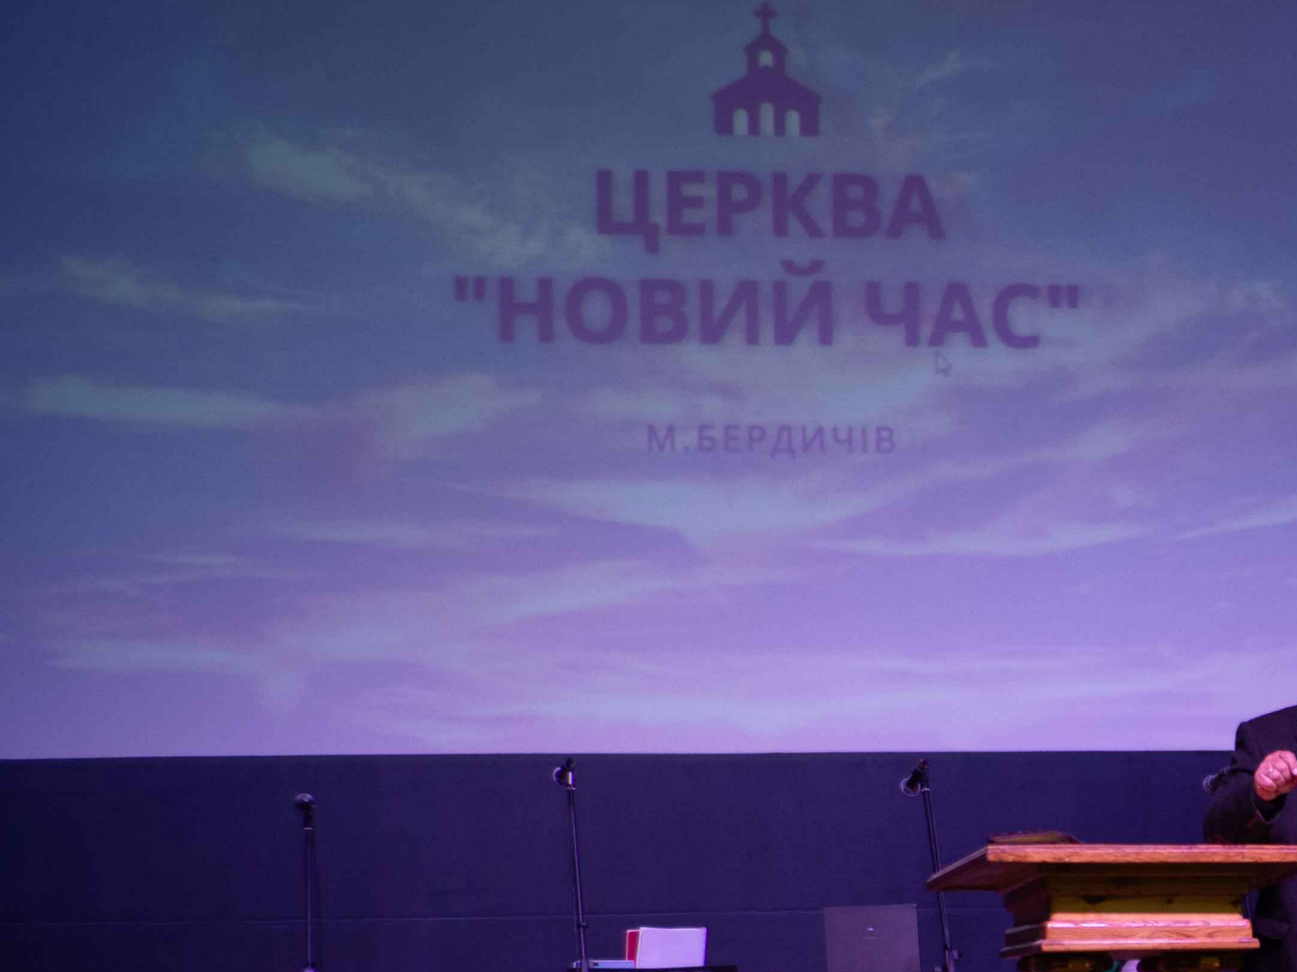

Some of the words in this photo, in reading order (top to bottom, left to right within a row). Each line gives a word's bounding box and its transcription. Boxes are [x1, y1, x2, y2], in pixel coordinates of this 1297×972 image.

[595, 168, 946, 254] ЦЕРКВА
[454, 258, 835, 346] "НОВИЙ
[863, 280, 1080, 349] ЧАС"
